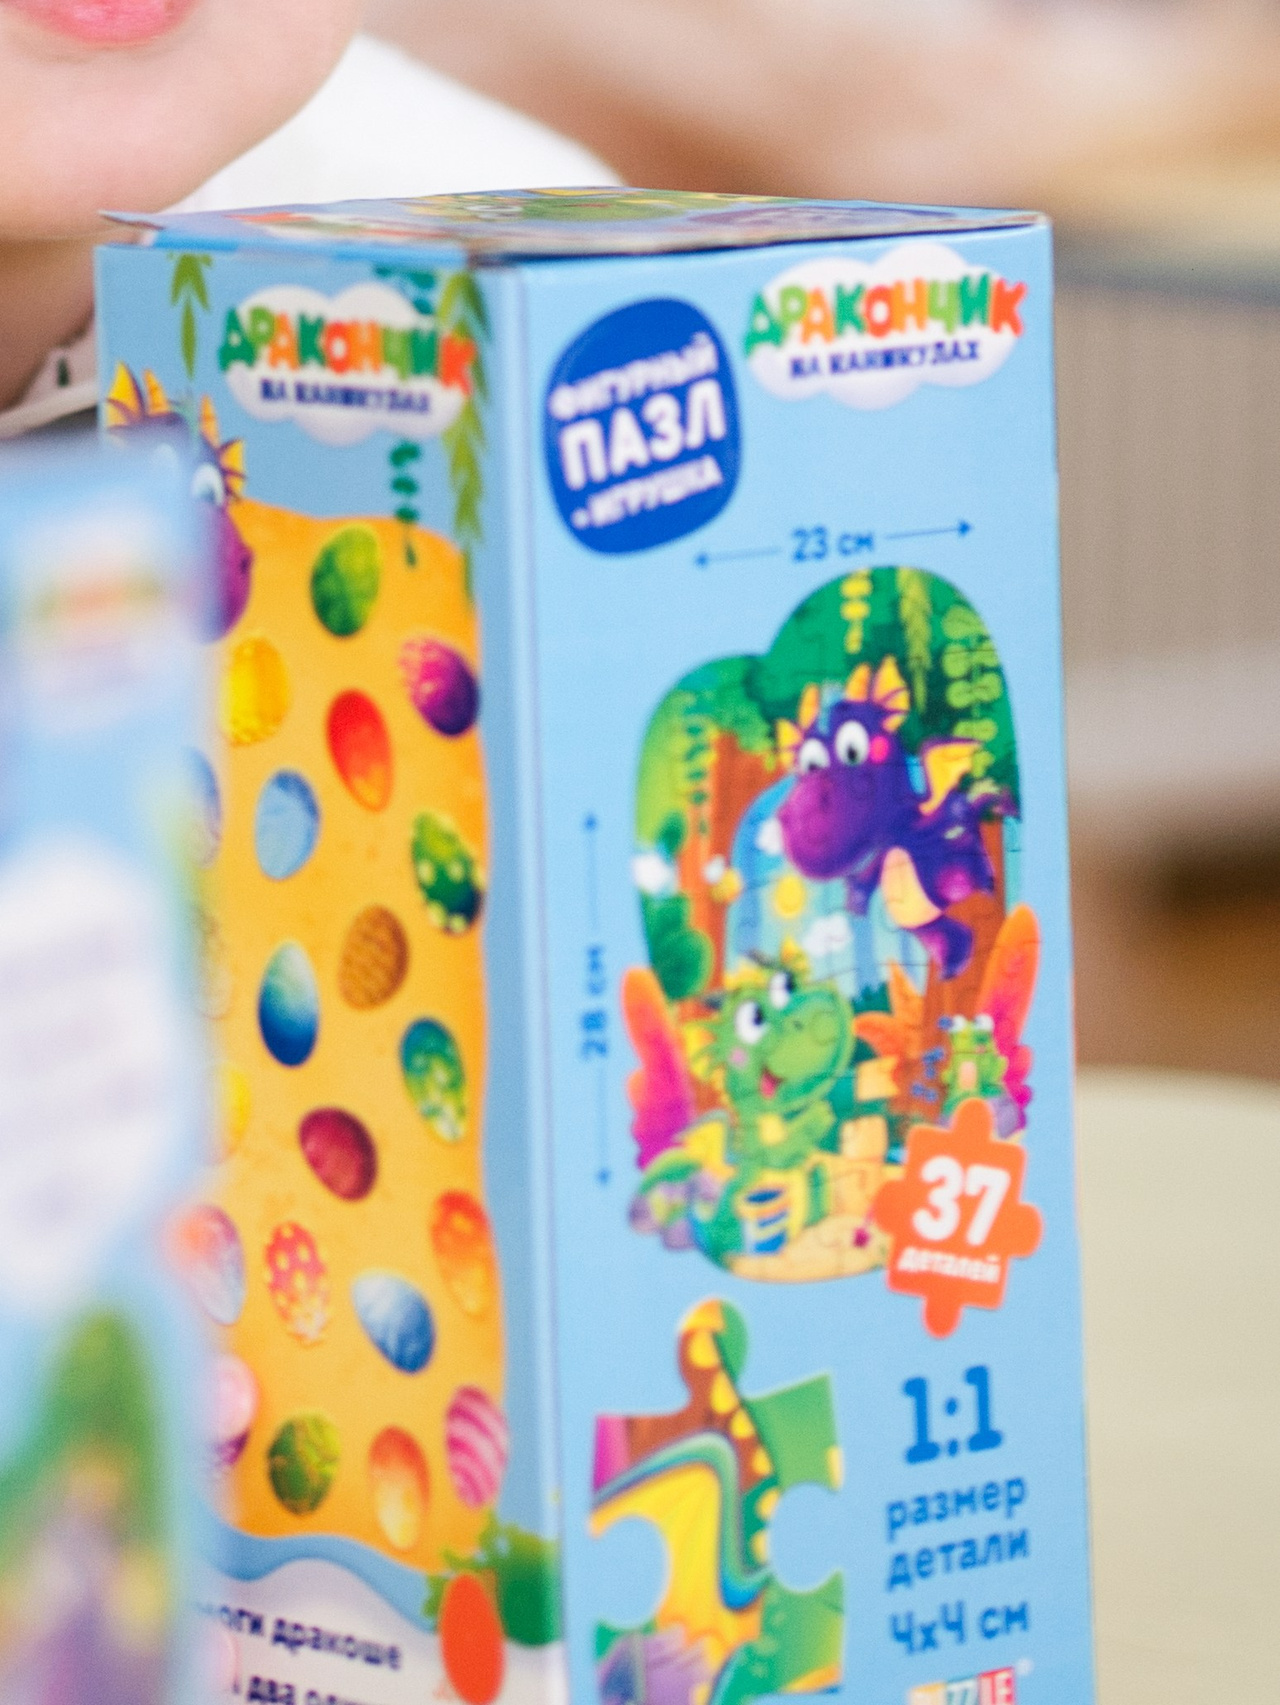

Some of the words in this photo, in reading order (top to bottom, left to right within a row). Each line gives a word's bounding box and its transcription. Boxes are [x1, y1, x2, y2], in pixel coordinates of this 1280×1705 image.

[743, 272, 1028, 358] ДРАКОНЧИК
[558, 377, 727, 492] ПАЗЛ
[791, 525, 828, 564] 23
[836, 531, 875, 558] см
[911, 1154, 1012, 1246] 37
[902, 1364, 1004, 1464] 1:1
[886, 1476, 1026, 1544] размер
[886, 1528, 1028, 1593] детали
[978, 1601, 1029, 1640] см
